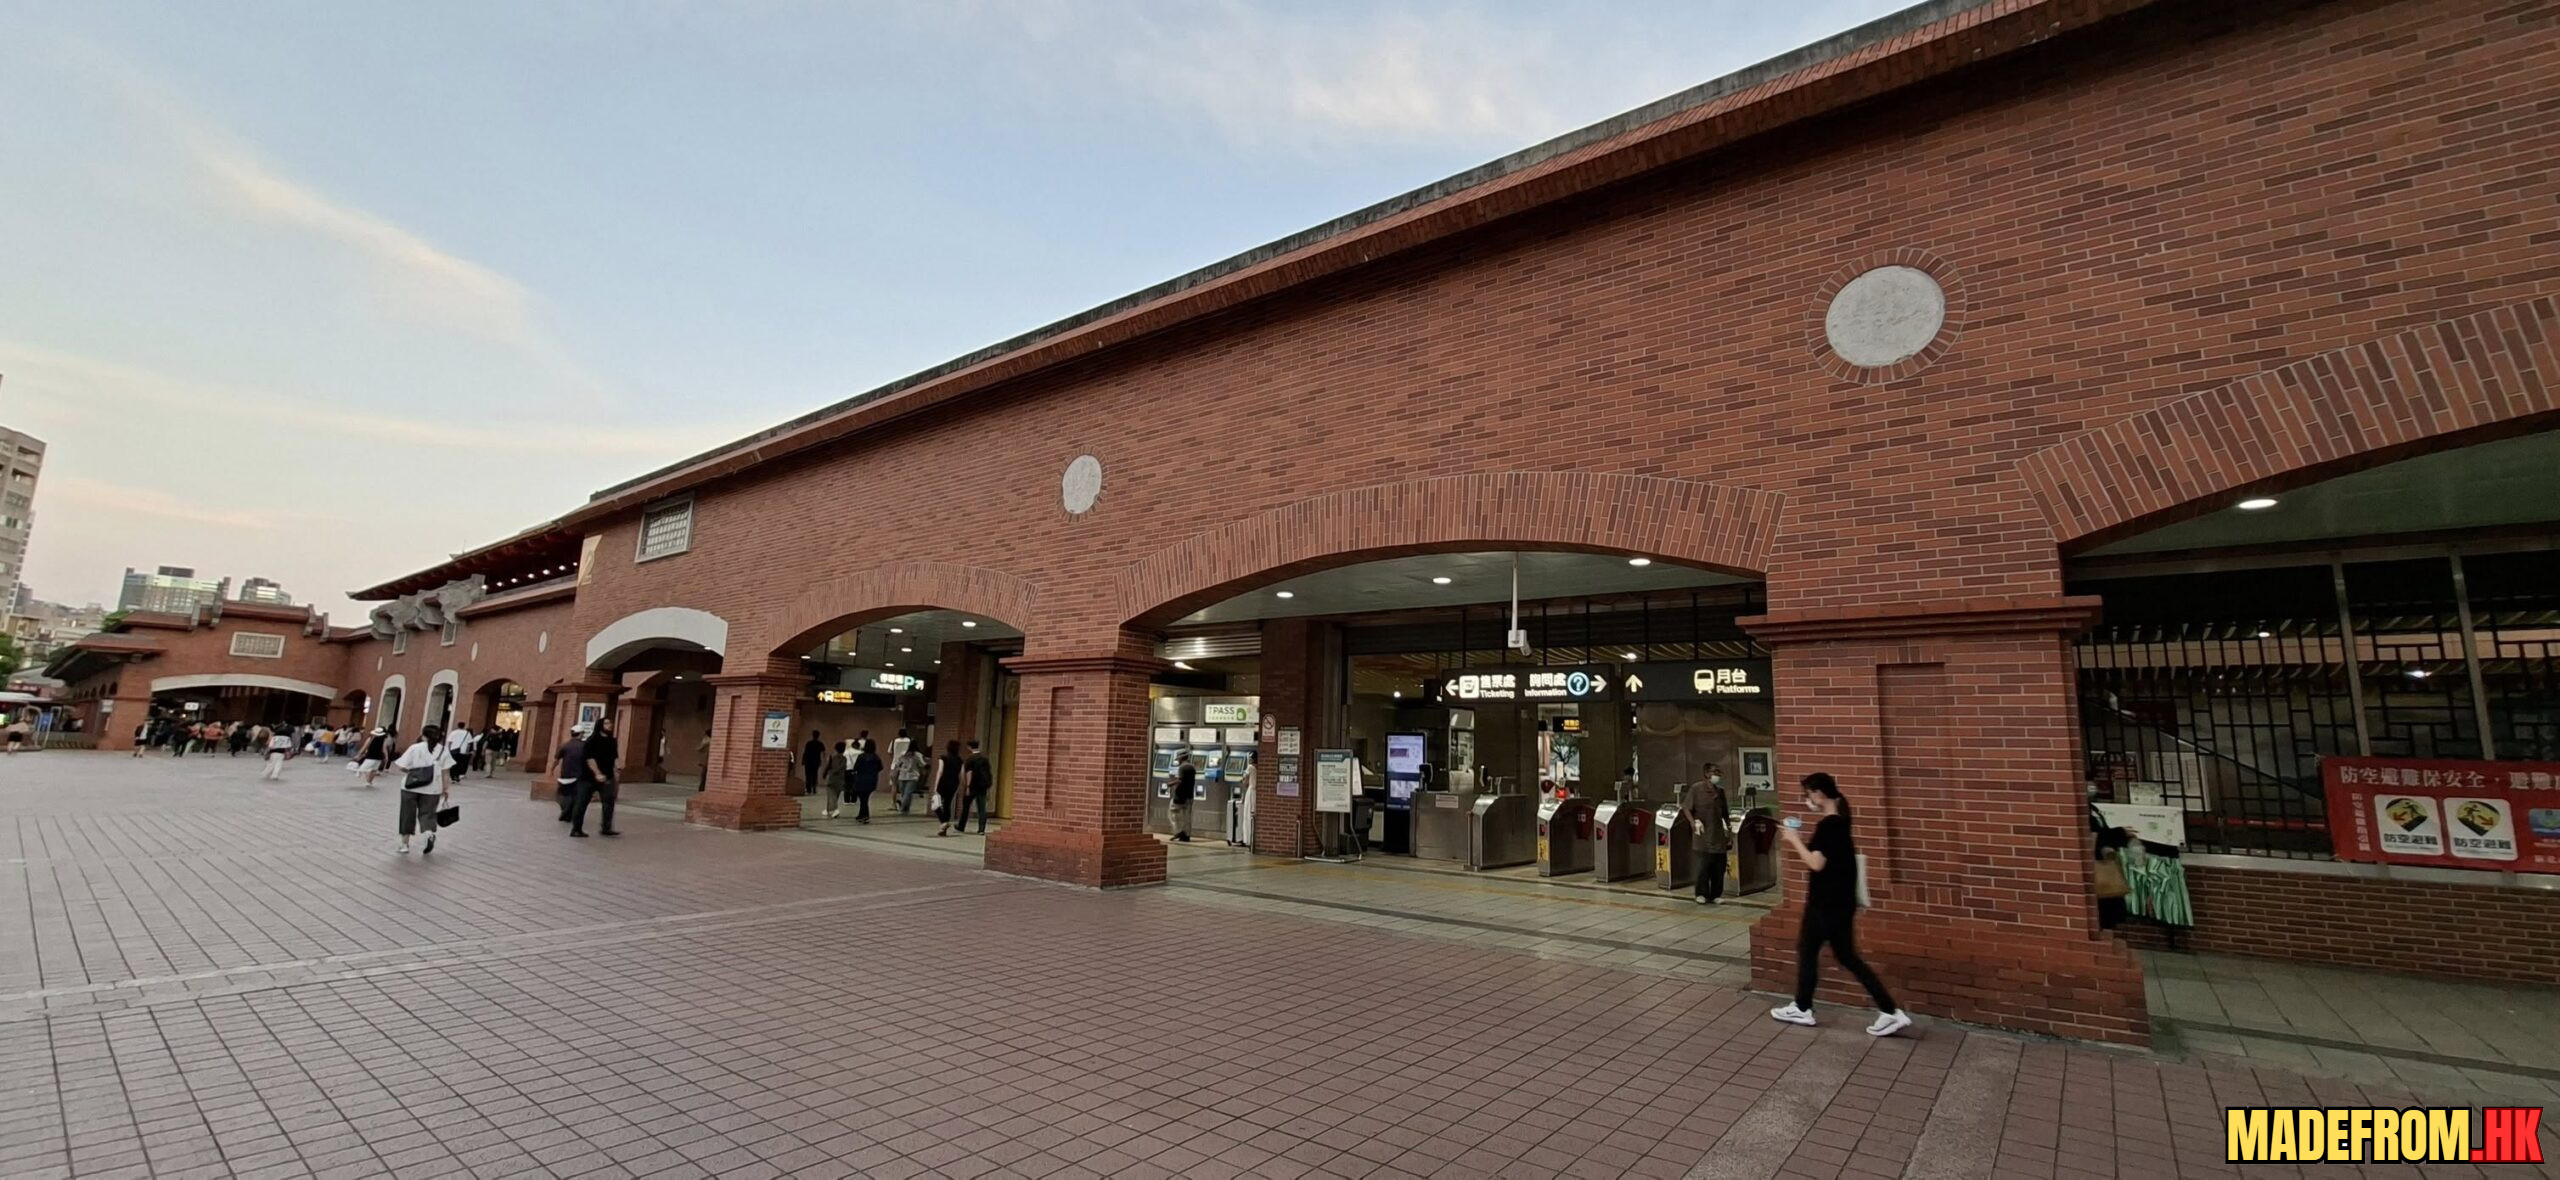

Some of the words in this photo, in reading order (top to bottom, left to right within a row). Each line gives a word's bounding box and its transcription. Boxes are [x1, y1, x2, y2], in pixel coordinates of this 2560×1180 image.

[1716, 668, 1747, 684] 月台
[1480, 689, 1515, 699] Ticketing
[1525, 688, 1567, 698] Information
[1716, 685, 1760, 694] Platforms
